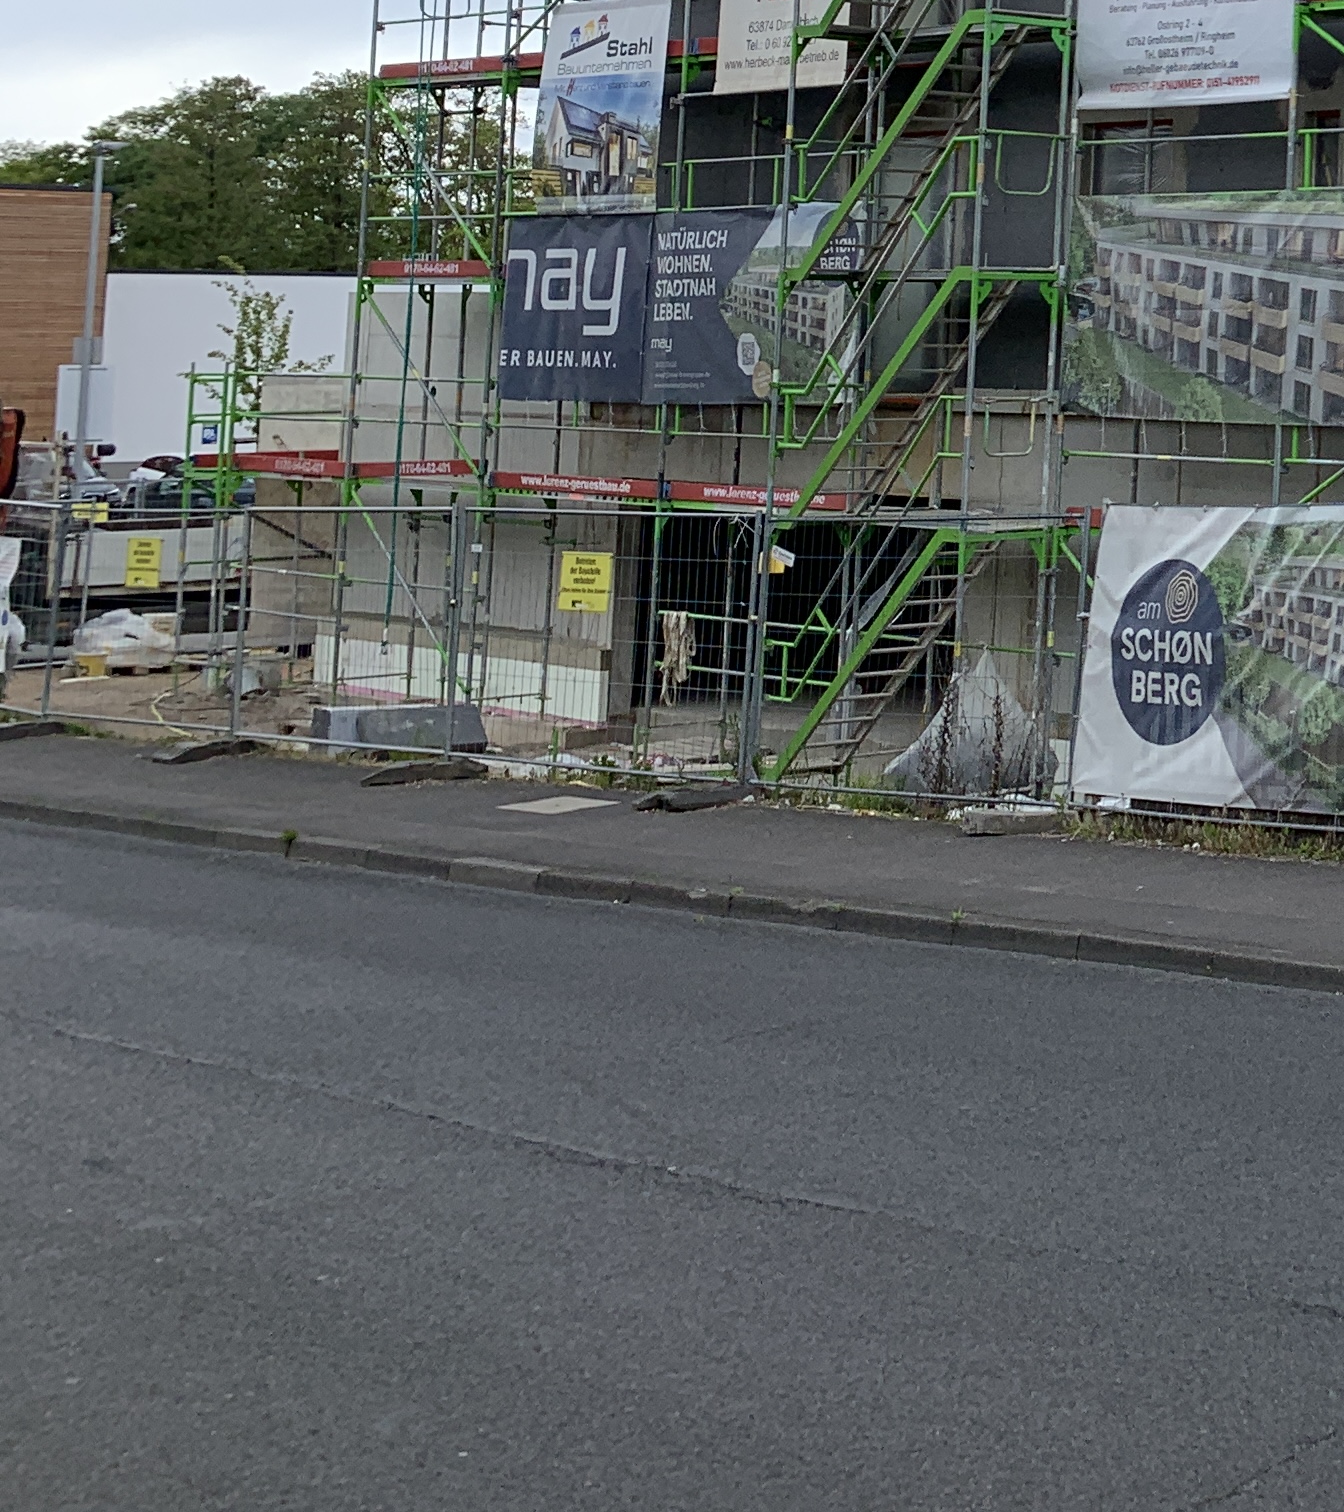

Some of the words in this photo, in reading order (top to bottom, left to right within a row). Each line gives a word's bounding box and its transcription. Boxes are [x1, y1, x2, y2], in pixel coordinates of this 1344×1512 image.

[606, 36, 653, 58] Stahl
[557, 58, 652, 76] Bauunternehmen
[657, 227, 728, 251] NATÜRLICH
[657, 254, 713, 274] WOHNEN.
[819, 256, 851, 270] BERG
[654, 277, 716, 298] STADTNAH
[653, 303, 694, 322] LEBEN.
[521, 474, 631, 494] www.lorenz-geruestbau.de
[1137, 600, 1162, 620] am
[1120, 626, 1213, 665] SCHØN
[1131, 669, 1203, 708] BERG
